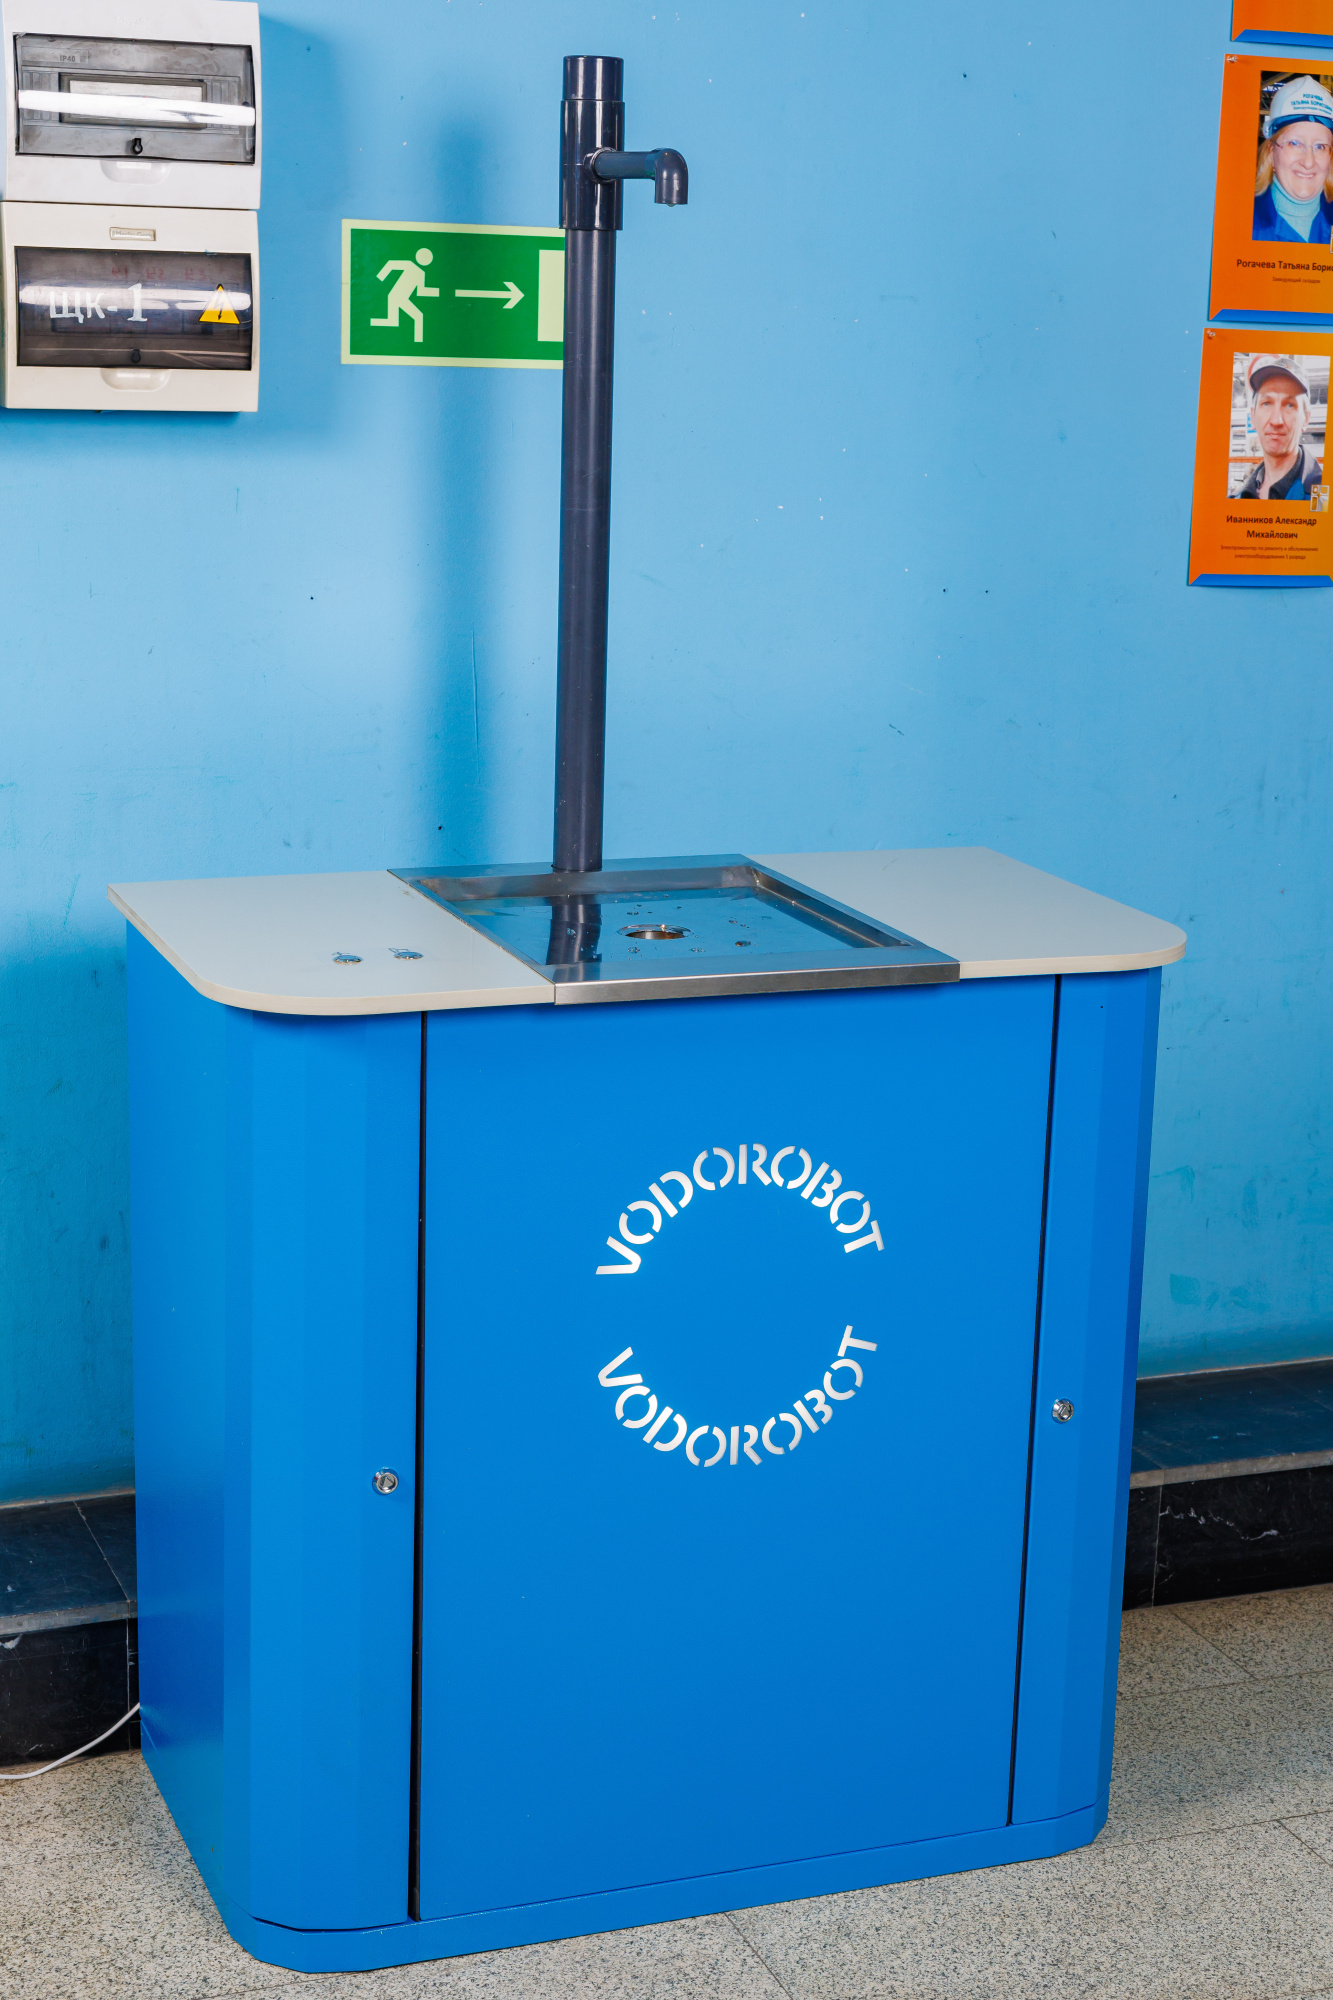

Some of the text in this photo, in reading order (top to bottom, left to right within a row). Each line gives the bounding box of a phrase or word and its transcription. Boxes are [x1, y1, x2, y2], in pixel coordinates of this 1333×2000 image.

[1236, 258, 1276, 269] Рогачева
[1278, 260, 1310, 271] Татьяна
[50, 283, 148, 323] ЩК-1
[1226, 515, 1317, 526] Иванников Александр
[1246, 530, 1298, 539] Михайлович
[596, 1143, 884, 1275] VODOROBOT
[598, 1324, 878, 1468] VODOROBOT
